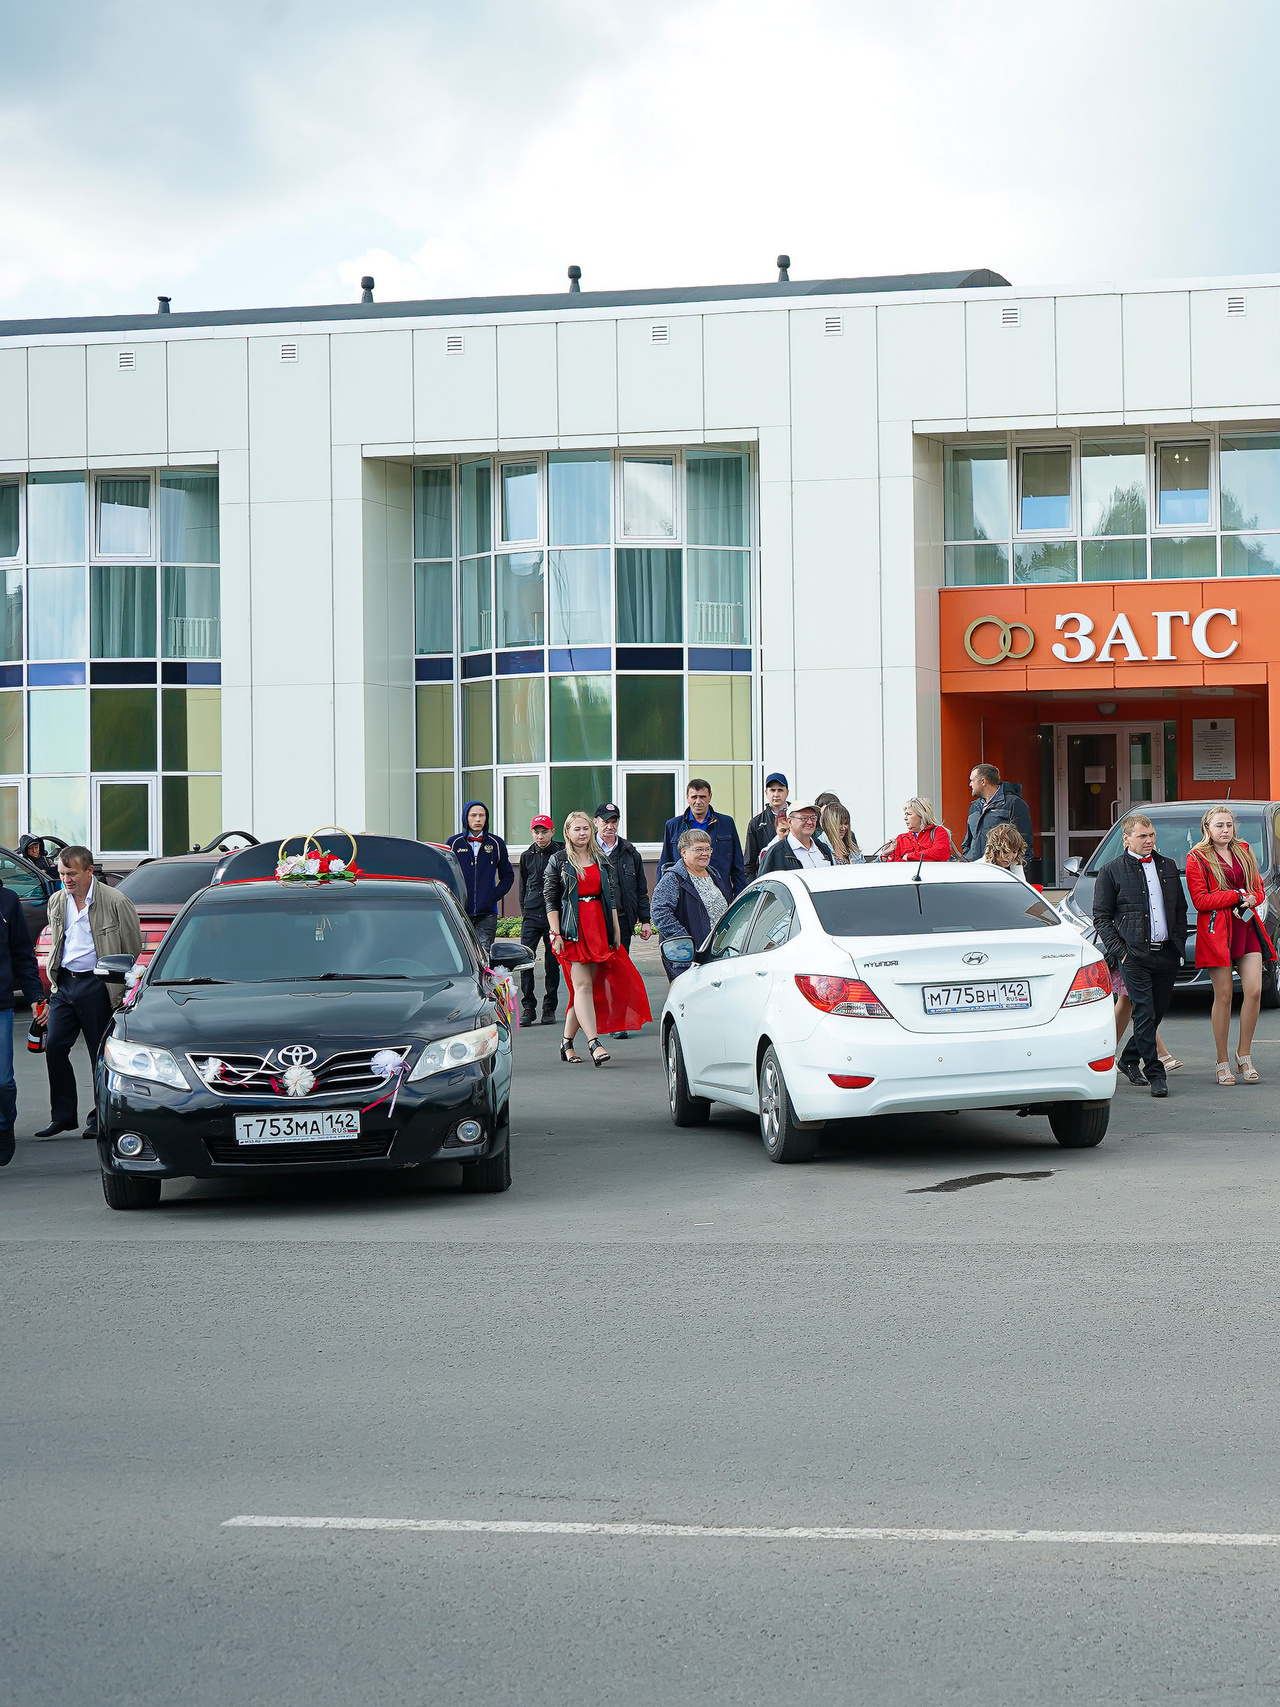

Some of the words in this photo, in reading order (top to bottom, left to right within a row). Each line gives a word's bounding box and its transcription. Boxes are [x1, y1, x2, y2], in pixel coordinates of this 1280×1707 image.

[1052, 608, 1239, 663] ЗАГС
[863, 960, 899, 968] HYUNDAI
[1000, 983, 1024, 997] 142
[325, 1113, 355, 1129] 142
